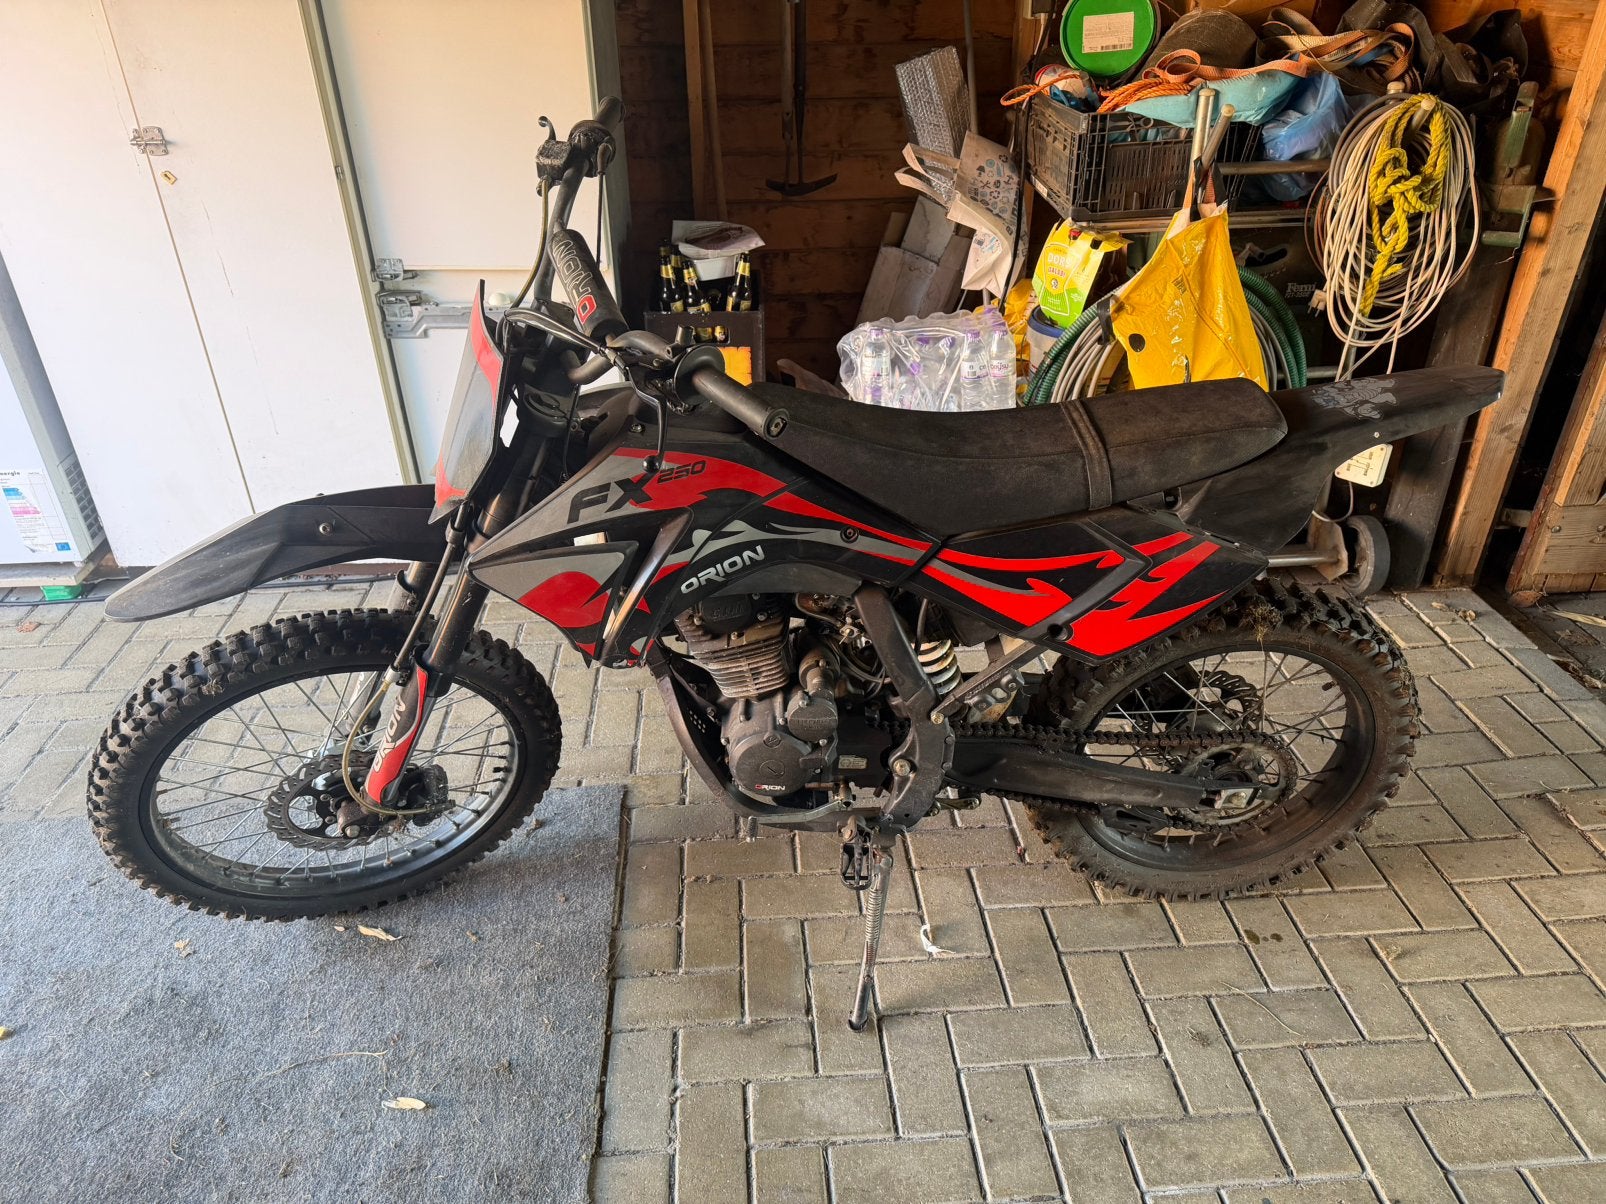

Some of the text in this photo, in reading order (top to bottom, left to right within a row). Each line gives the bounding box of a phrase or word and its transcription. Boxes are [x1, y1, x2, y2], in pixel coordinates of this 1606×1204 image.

[552, 239, 597, 325] ORION
[566, 459, 707, 524] FX 250
[680, 544, 766, 594] ORION
[372, 695, 407, 774] ORION
